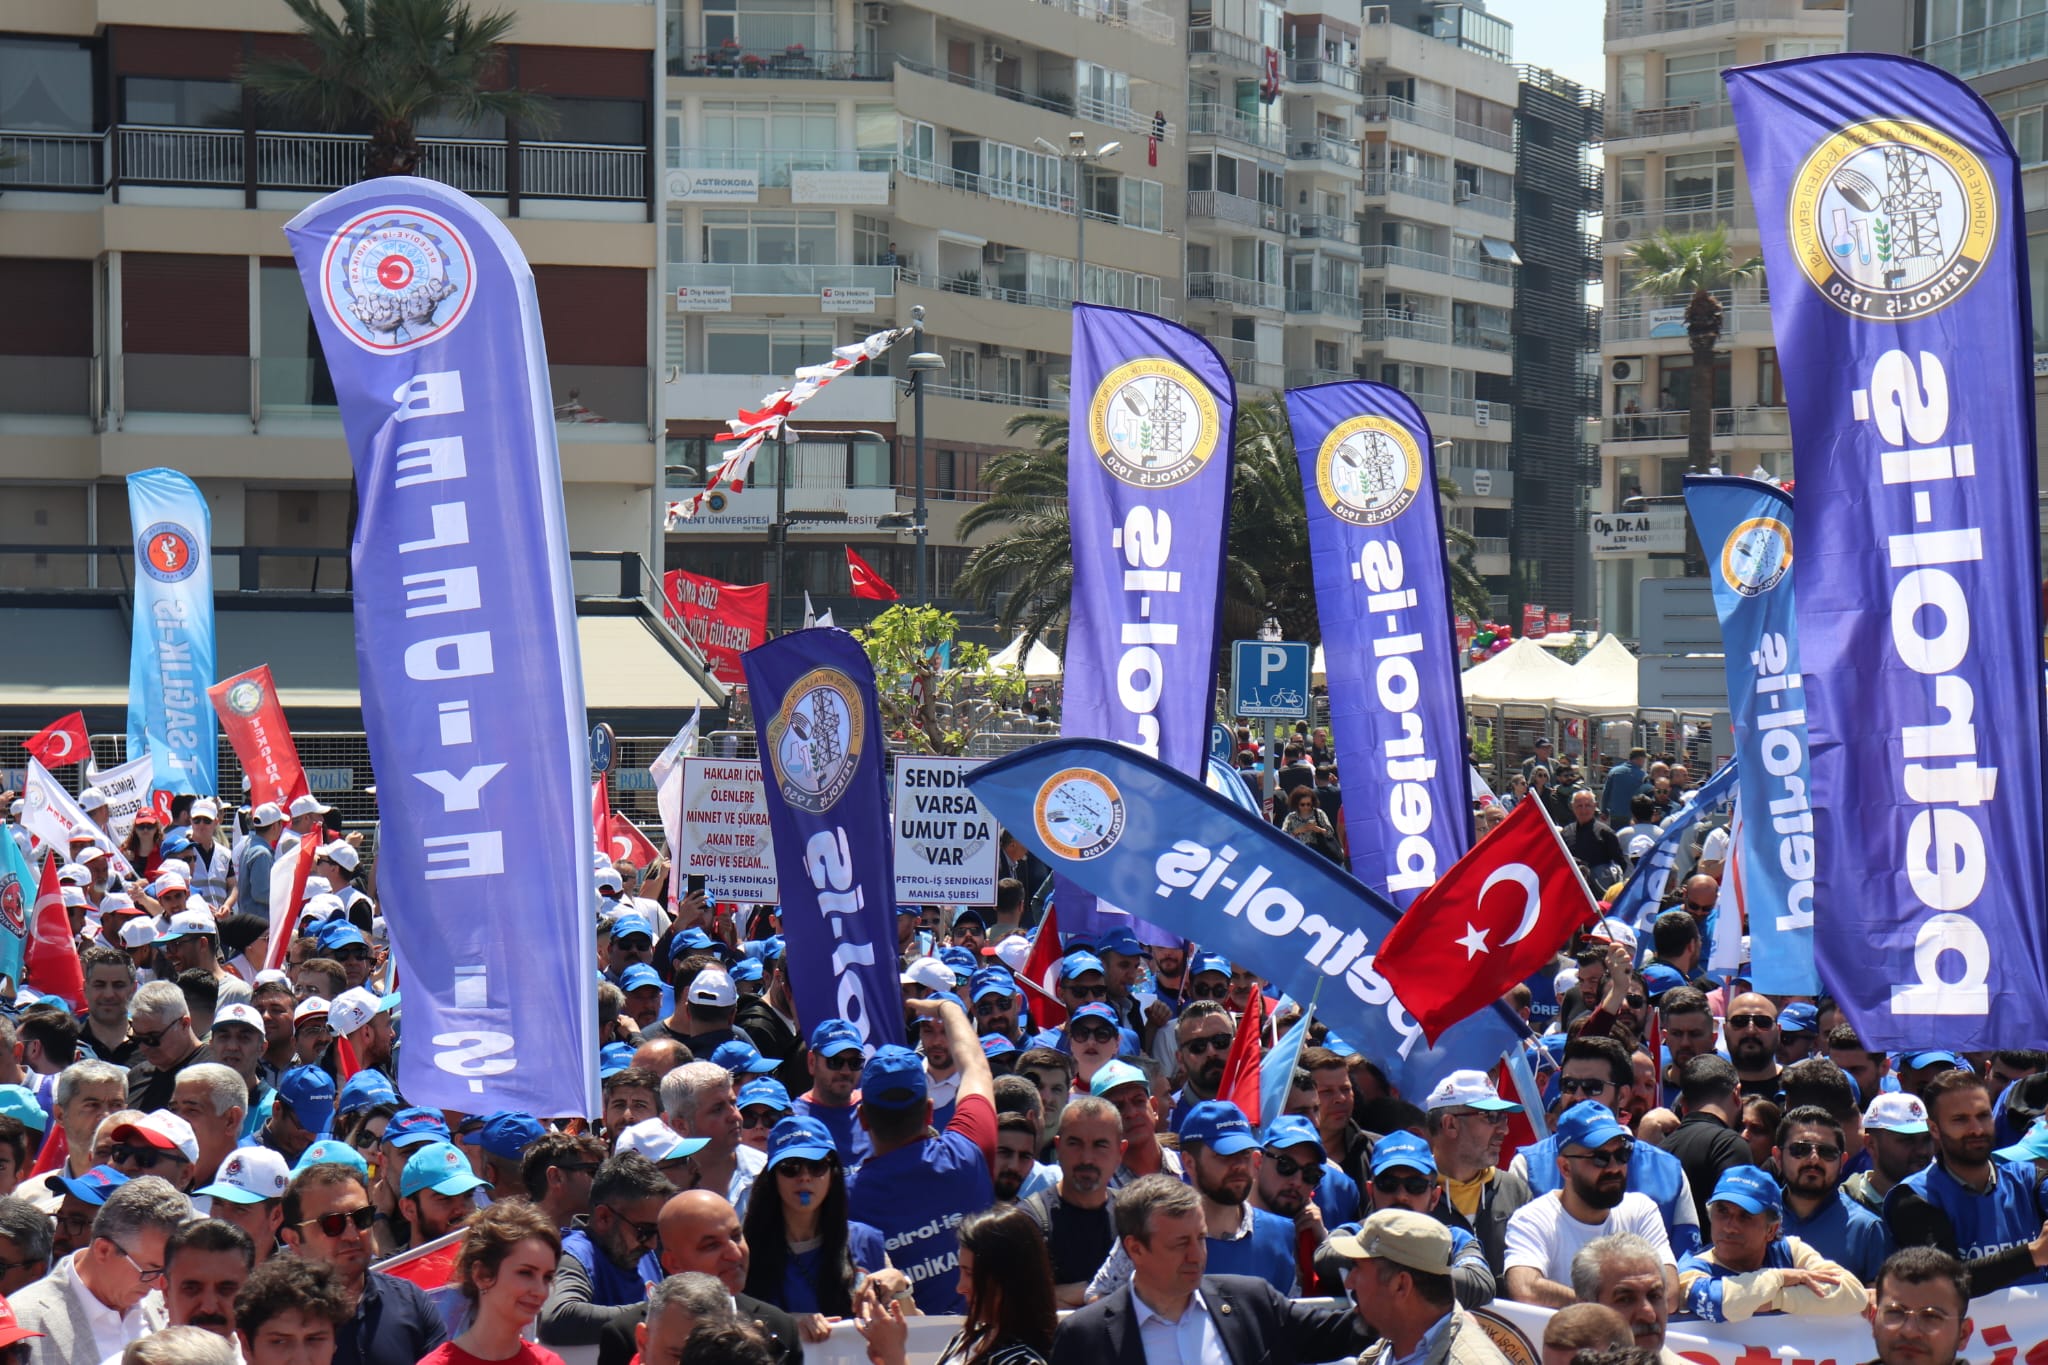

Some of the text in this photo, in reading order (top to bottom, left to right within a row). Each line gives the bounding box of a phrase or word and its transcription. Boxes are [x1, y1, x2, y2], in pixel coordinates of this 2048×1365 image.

[708, 514, 770, 525] ÜNİVERSİTESİ
[1616, 518, 1634, 533] Dr.
[698, 581, 719, 610] SÖZ!
[709, 618, 752, 653] GÜLECEK!
[1261, 646, 1287, 686] P
[596, 728, 605, 753] P
[1212, 730, 1222, 752] P
[310, 769, 350, 790] POLİS
[704, 767, 743, 781] HAKLARI
[905, 765, 969, 789] SENDİ
[711, 785, 755, 804] ÖLENLERE
[915, 795, 978, 815] VARSA
[686, 807, 722, 824] MİNNET
[724, 811, 735, 824] VE
[706, 833, 755, 847] AKAN TERE
[901, 820, 991, 840] UMUT DA
[690, 854, 769, 870] SAYGI VE SELAM...
[925, 846, 964, 866] VAR
[682, 873, 776, 885] POL-İŞ SENDİKASI
[895, 874, 993, 887] PETROL-İŞ SENDİKASI
[708, 887, 763, 899] NİSA ŞUBESİ
[908, 889, 979, 901] MANİSA ŞUBESİ
[885, 1212, 963, 1251] etrol-iş
[900, 1251, 961, 1284] NDİKA
[1500, 1334, 1527, 1365] İŞÇİLE
